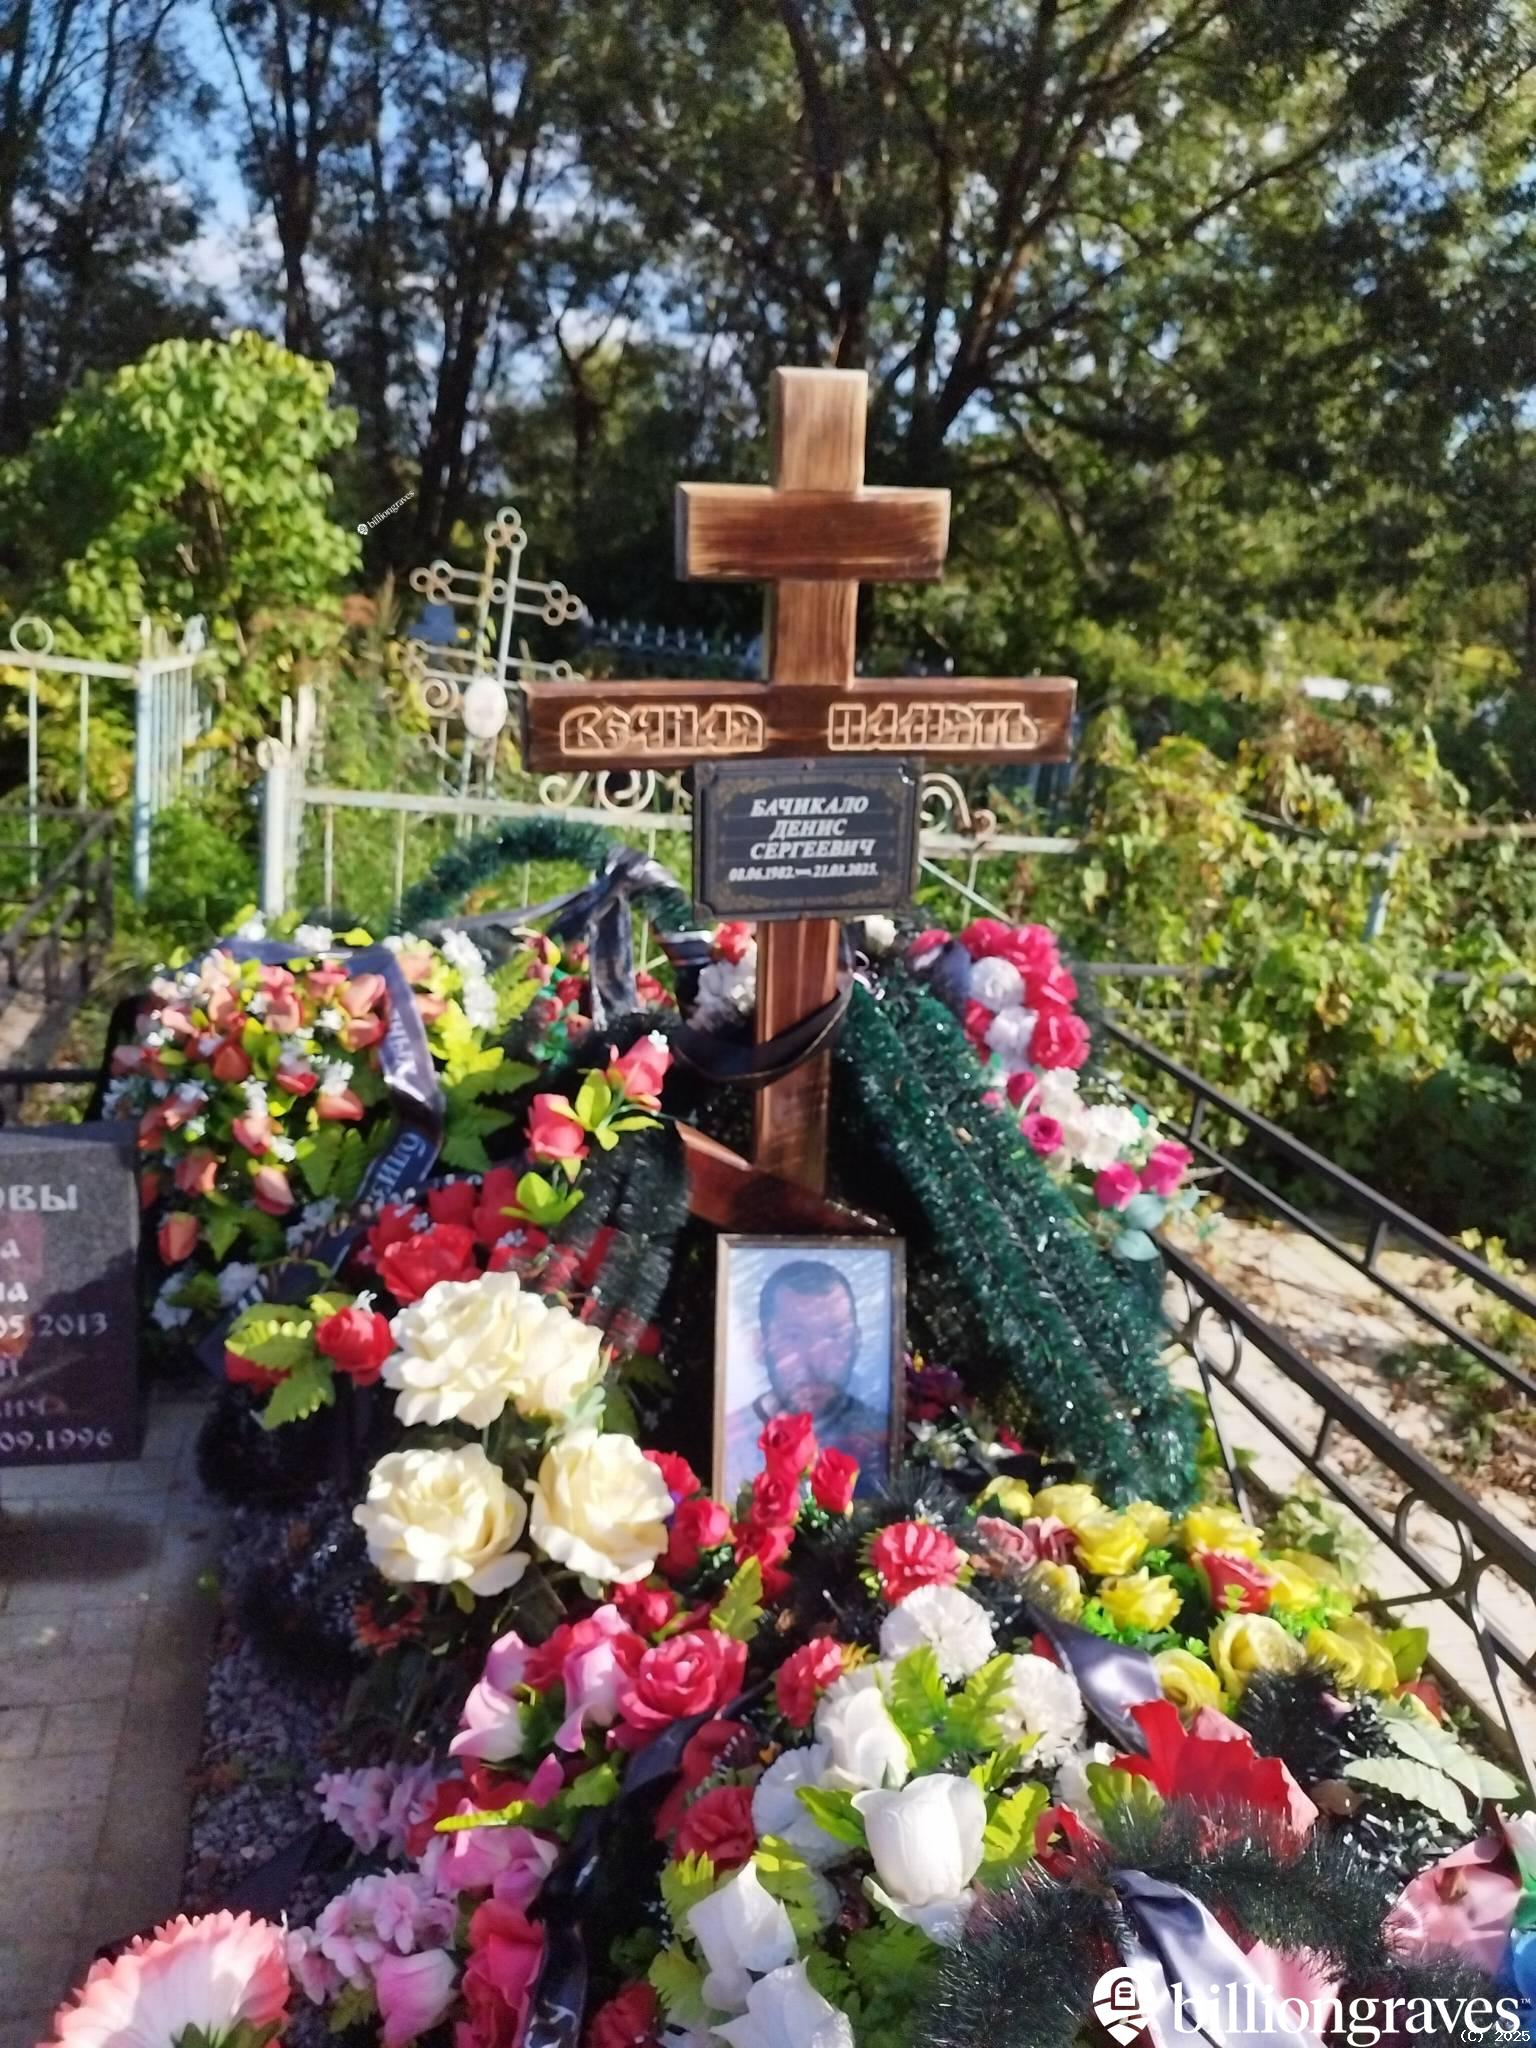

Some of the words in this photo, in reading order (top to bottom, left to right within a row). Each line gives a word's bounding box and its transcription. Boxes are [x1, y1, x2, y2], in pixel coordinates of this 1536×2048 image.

[750, 796, 869, 817] БАЧИКАЛО
[769, 818, 848, 840] ДЕНИС
[750, 839, 876, 860] СЕРГЕЕВИЧ
[0, 1184, 78, 1212] ВЫ
